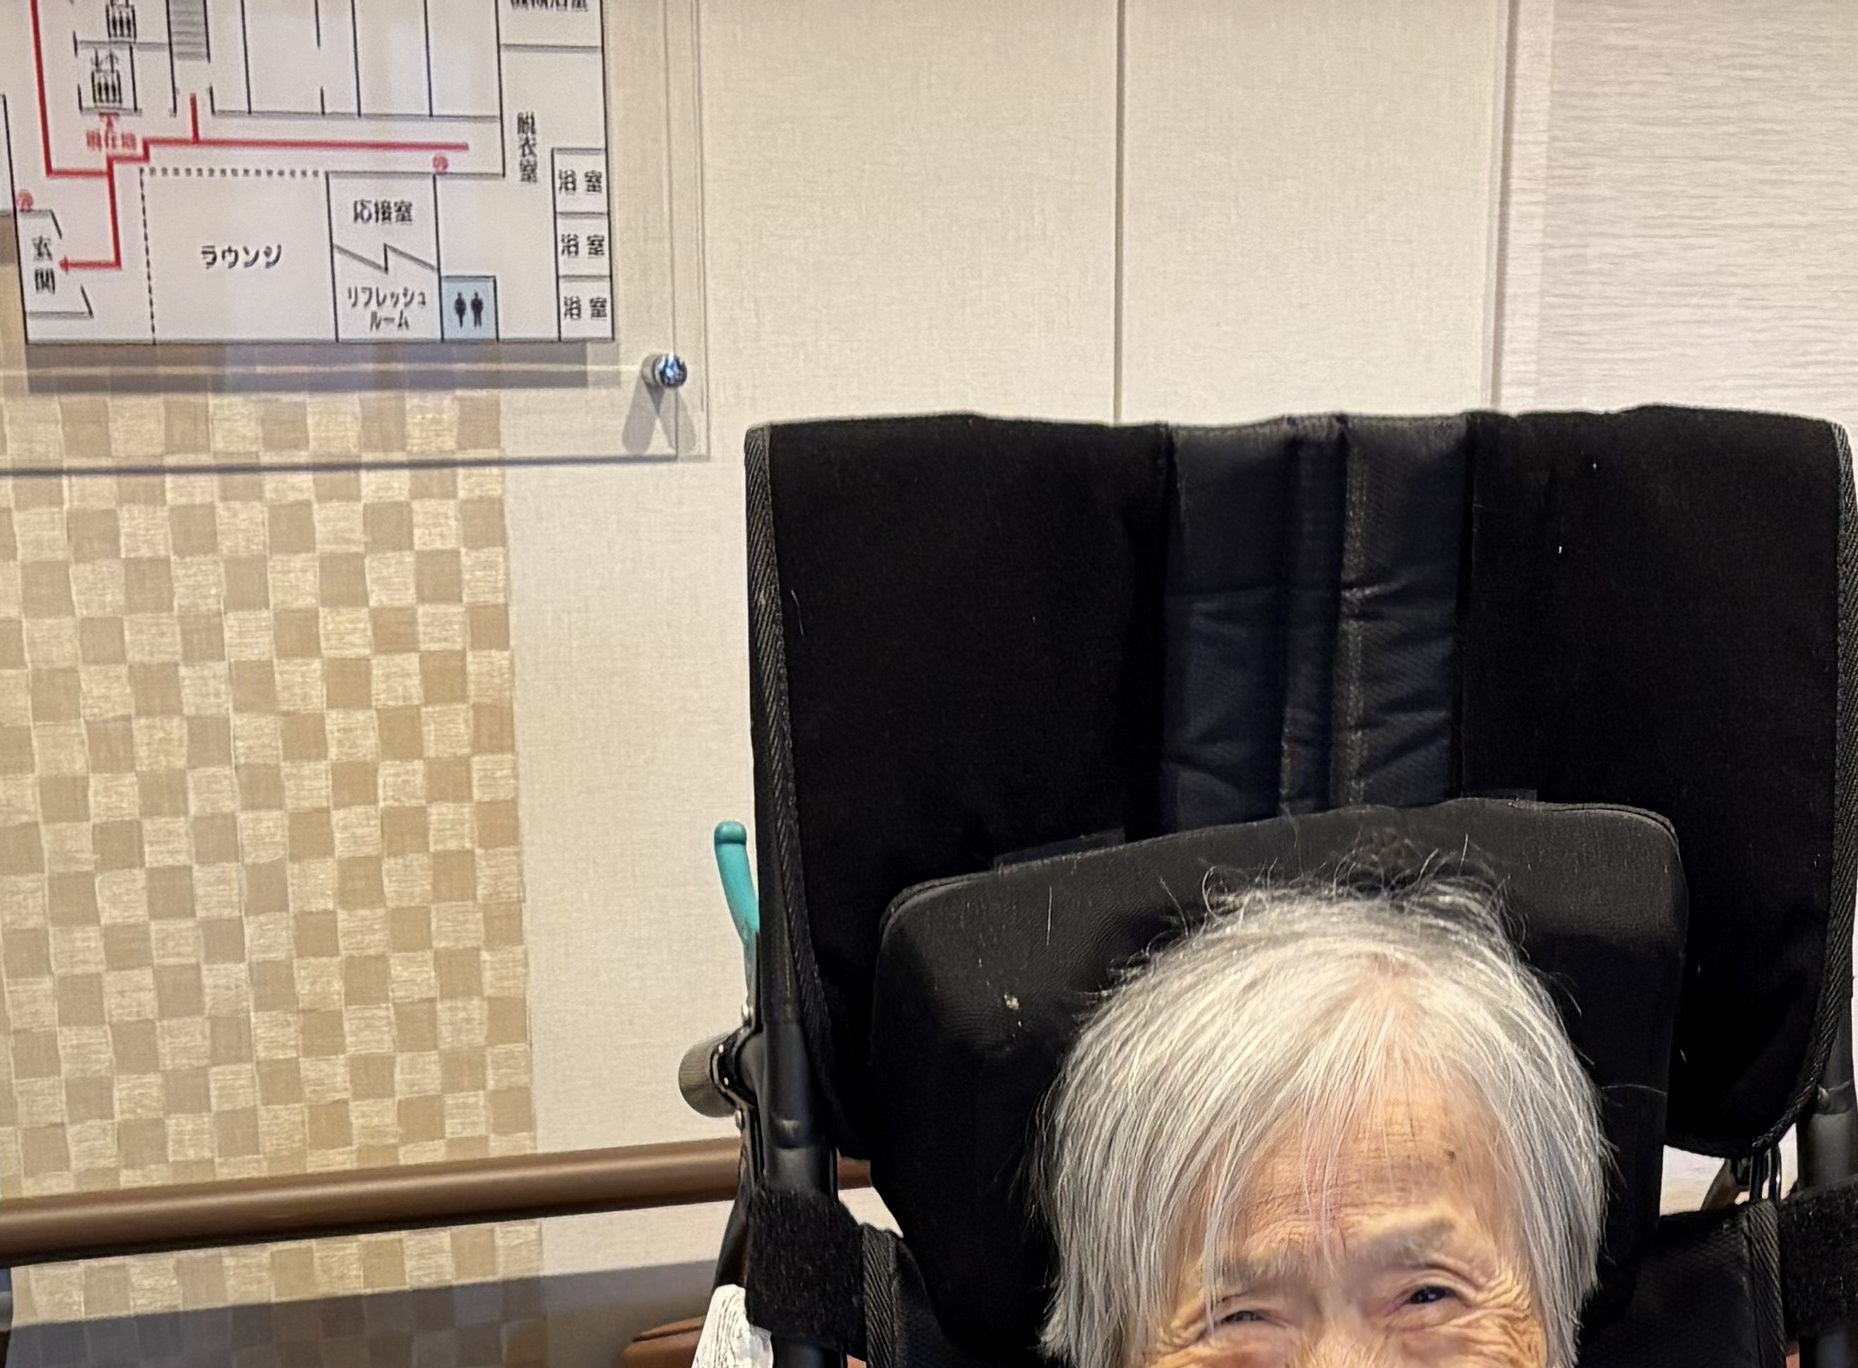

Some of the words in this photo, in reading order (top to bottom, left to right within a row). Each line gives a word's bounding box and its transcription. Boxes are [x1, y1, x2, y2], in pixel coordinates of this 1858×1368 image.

[516, 112, 539, 183] 脱衣室
[558, 169, 603, 194] 浴室
[352, 199, 414, 223] 応接室
[200, 244, 282, 269] ラウンジ
[560, 233, 606, 257] 浴室
[31, 236, 56, 294] 玄関
[347, 287, 427, 308] リフレッシュ
[563, 295, 608, 320] 浴室
[369, 309, 410, 331] ルーム
